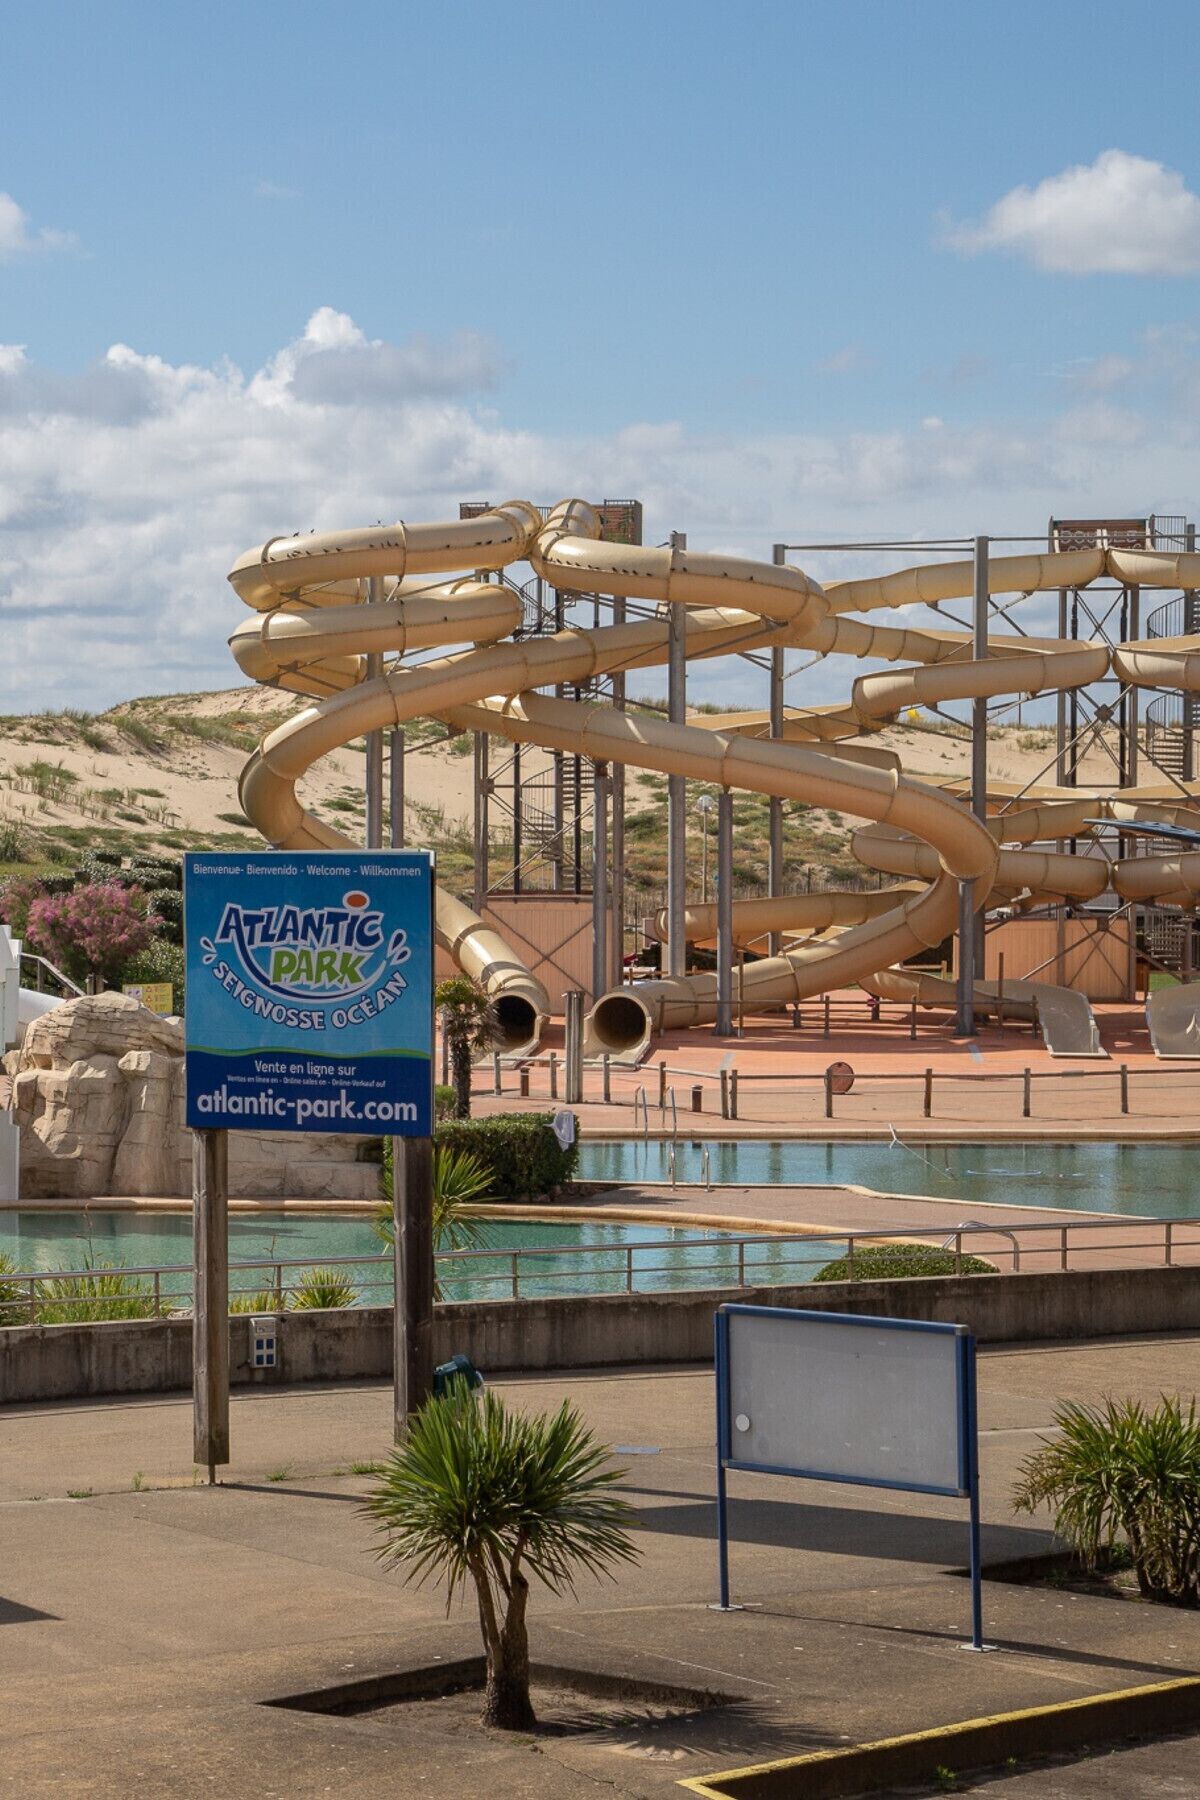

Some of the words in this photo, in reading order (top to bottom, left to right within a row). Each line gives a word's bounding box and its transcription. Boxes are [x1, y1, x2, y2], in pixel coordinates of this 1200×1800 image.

[1061, 530, 1137, 544] DOULE
[247, 864, 298, 876] Bienvenido
[307, 864, 350, 876] Welcome
[360, 865, 421, 877] Willkommen
[215, 892, 384, 950] ATLANTIC
[270, 948, 371, 988] PARK
[213, 960, 326, 1030] SEIGNOSSE
[331, 970, 409, 1029] OCÉAN
[255, 1060, 287, 1074] Vente
[290, 1063, 304, 1074] en
[306, 1061, 335, 1078] ligne
[338, 1065, 356, 1076] sur
[196, 1084, 418, 1125] atlantic-park.com
